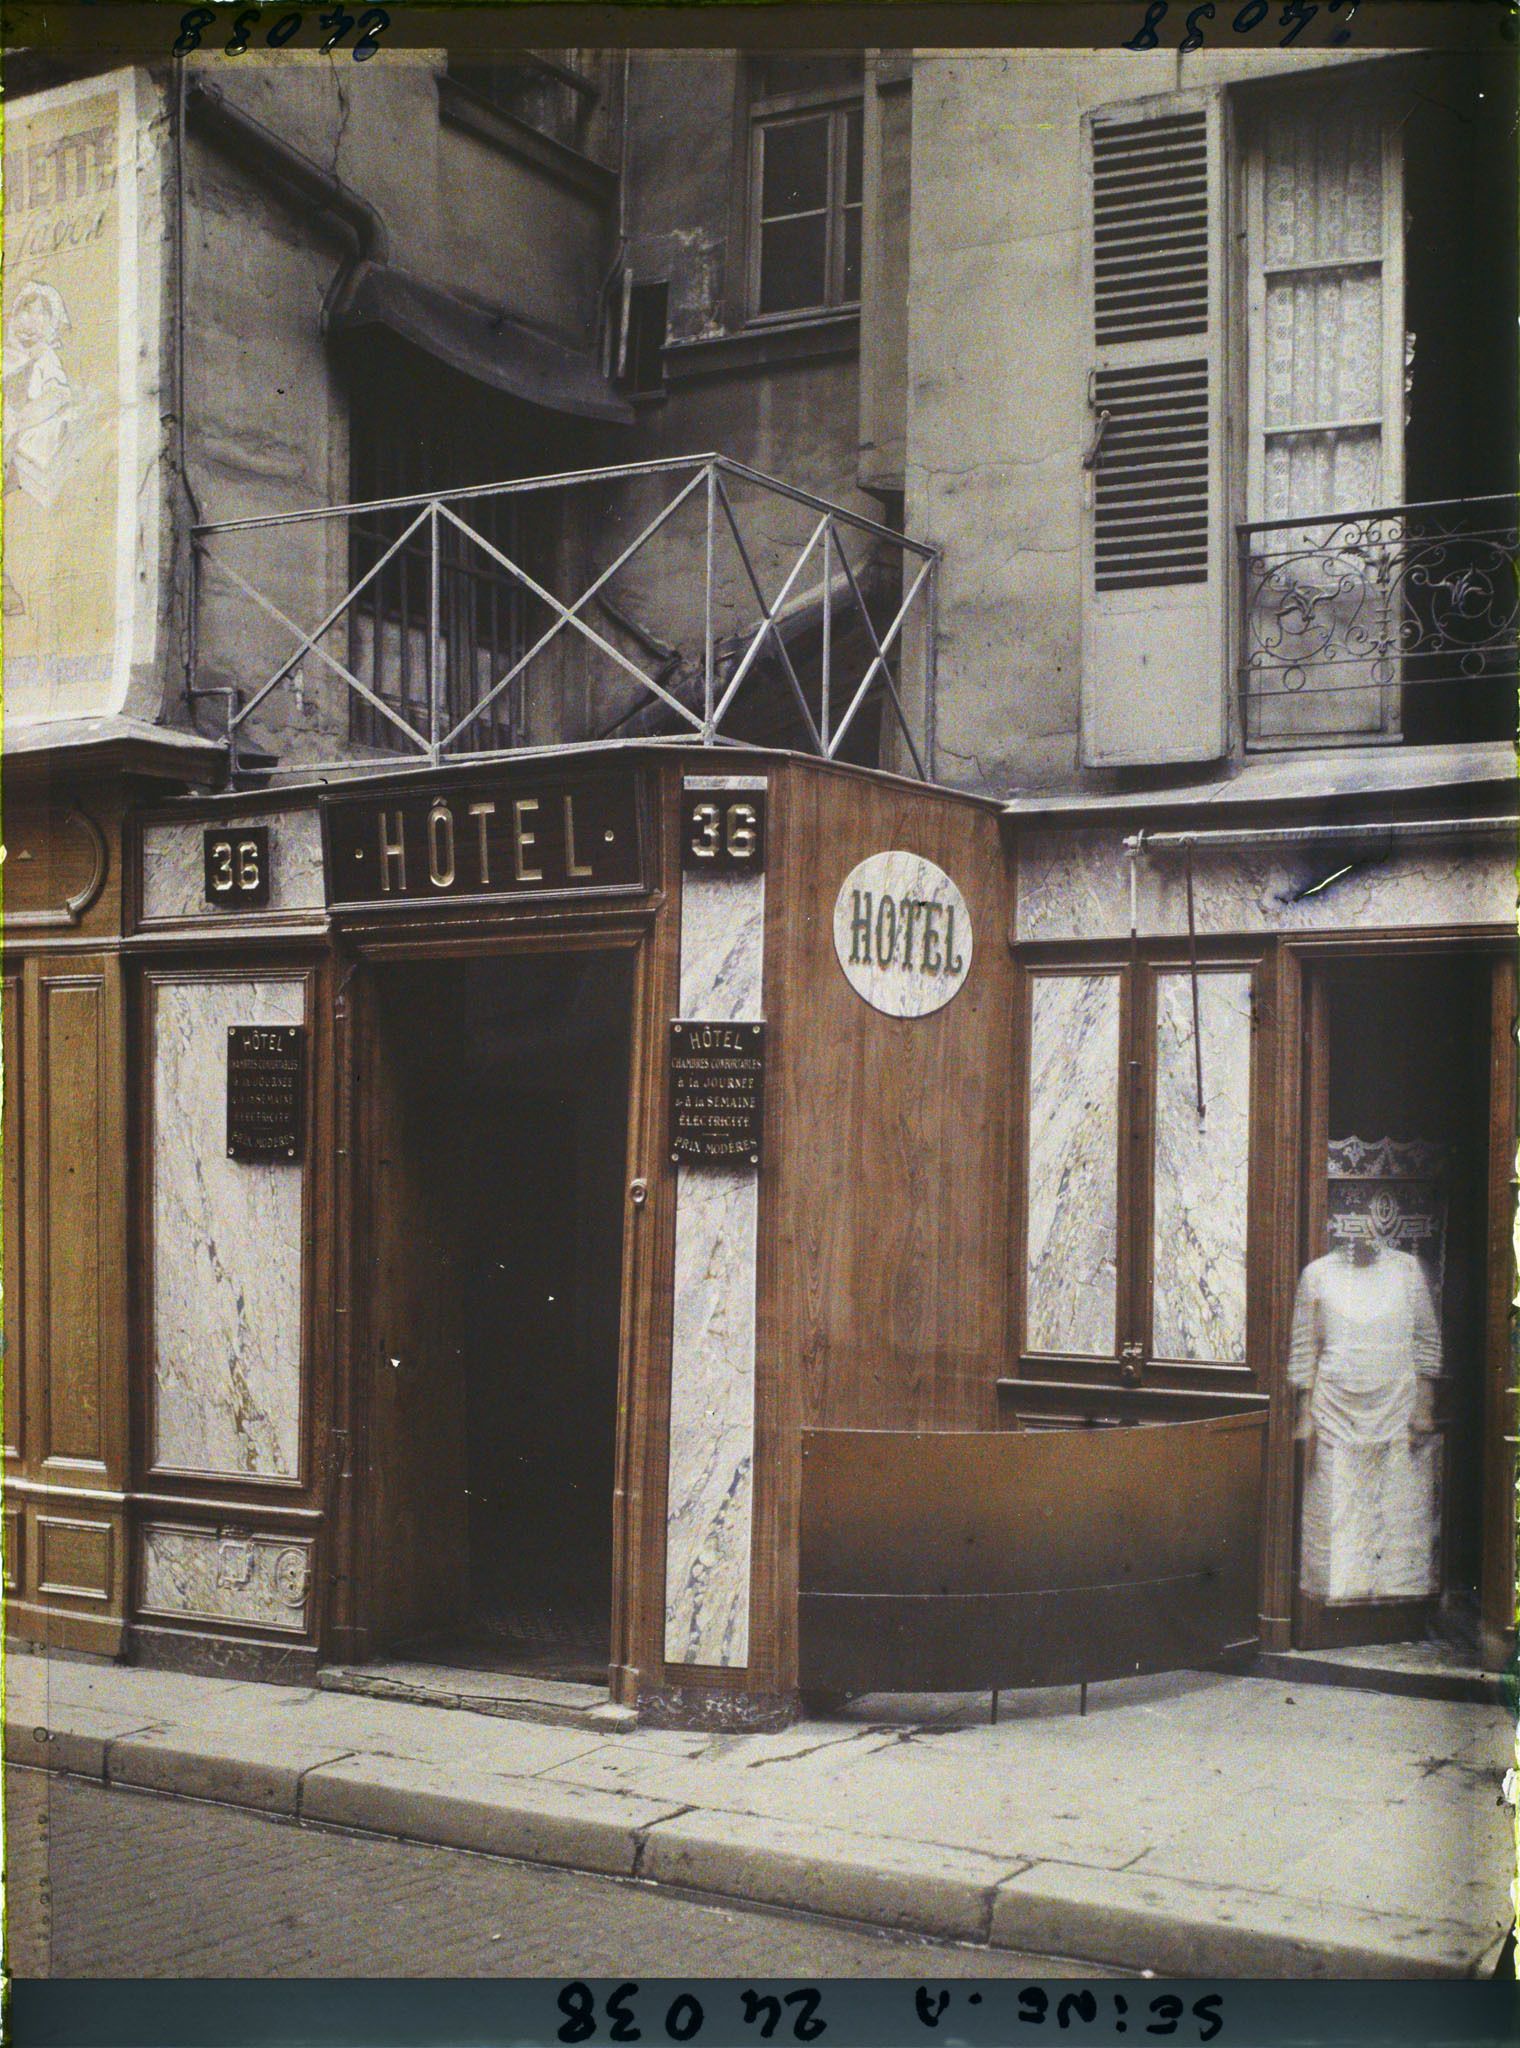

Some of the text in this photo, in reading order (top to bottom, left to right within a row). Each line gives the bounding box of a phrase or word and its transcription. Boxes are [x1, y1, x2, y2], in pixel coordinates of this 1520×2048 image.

[378, 796, 593, 891] HÔTEL
[691, 803, 757, 858] 36
[211, 841, 261, 891] 36
[848, 889, 964, 977] HOTEL
[689, 1026, 743, 1050] HÔTEL
[706, 1095, 756, 1108] SEMAINE
